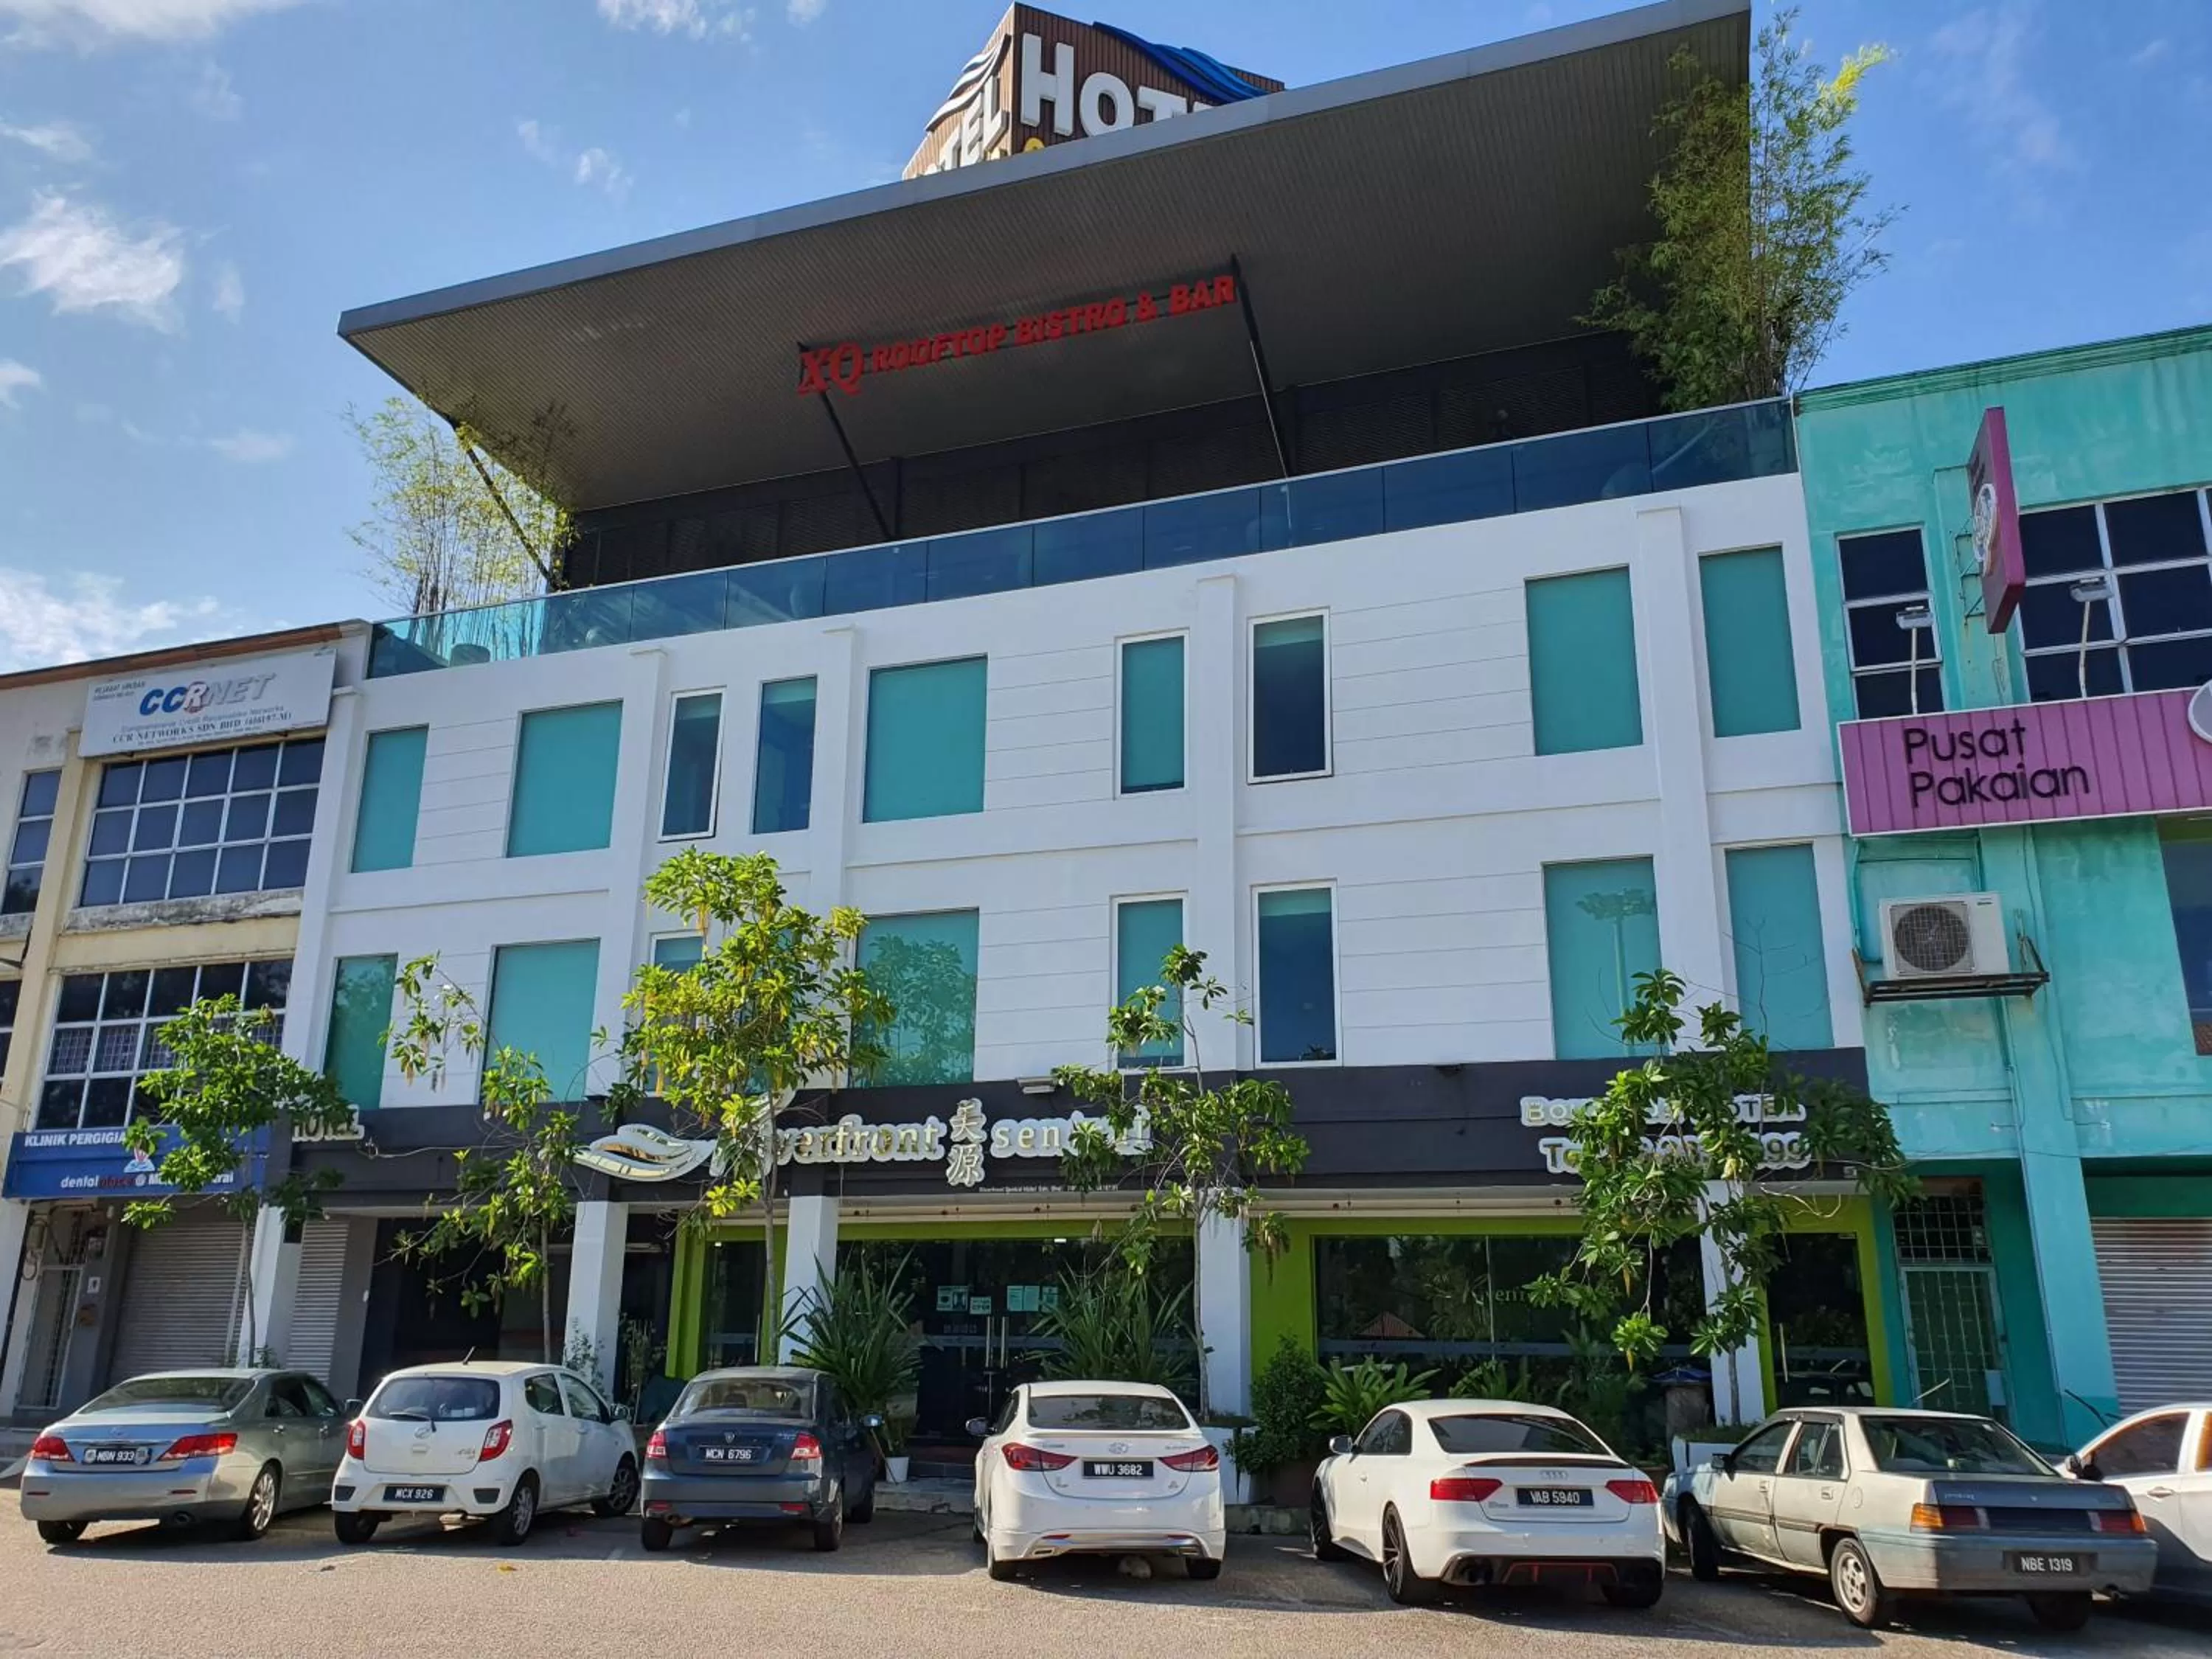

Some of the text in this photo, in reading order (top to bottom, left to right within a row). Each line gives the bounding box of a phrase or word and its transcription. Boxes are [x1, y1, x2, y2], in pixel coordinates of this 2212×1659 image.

[1020, 32, 1215, 139] HOT
[922, 73, 1009, 175] TEL
[797, 274, 1239, 396] XQ ROOFTOP BISTRO & BAR
[1903, 717, 2025, 765] Pusat
[1910, 762, 2090, 809] Pakaian
[24, 1131, 126, 1147] KLINIK PERGIGIA
[992, 1108, 1151, 1156] senl
[116, 1450, 135, 1461] 933
[728, 1449, 752, 1460] 6796
[1117, 1464, 1143, 1475] 3682
[1530, 1490, 1581, 1504] VAB 5940
[2020, 1557, 2073, 1572] NBE 1319
